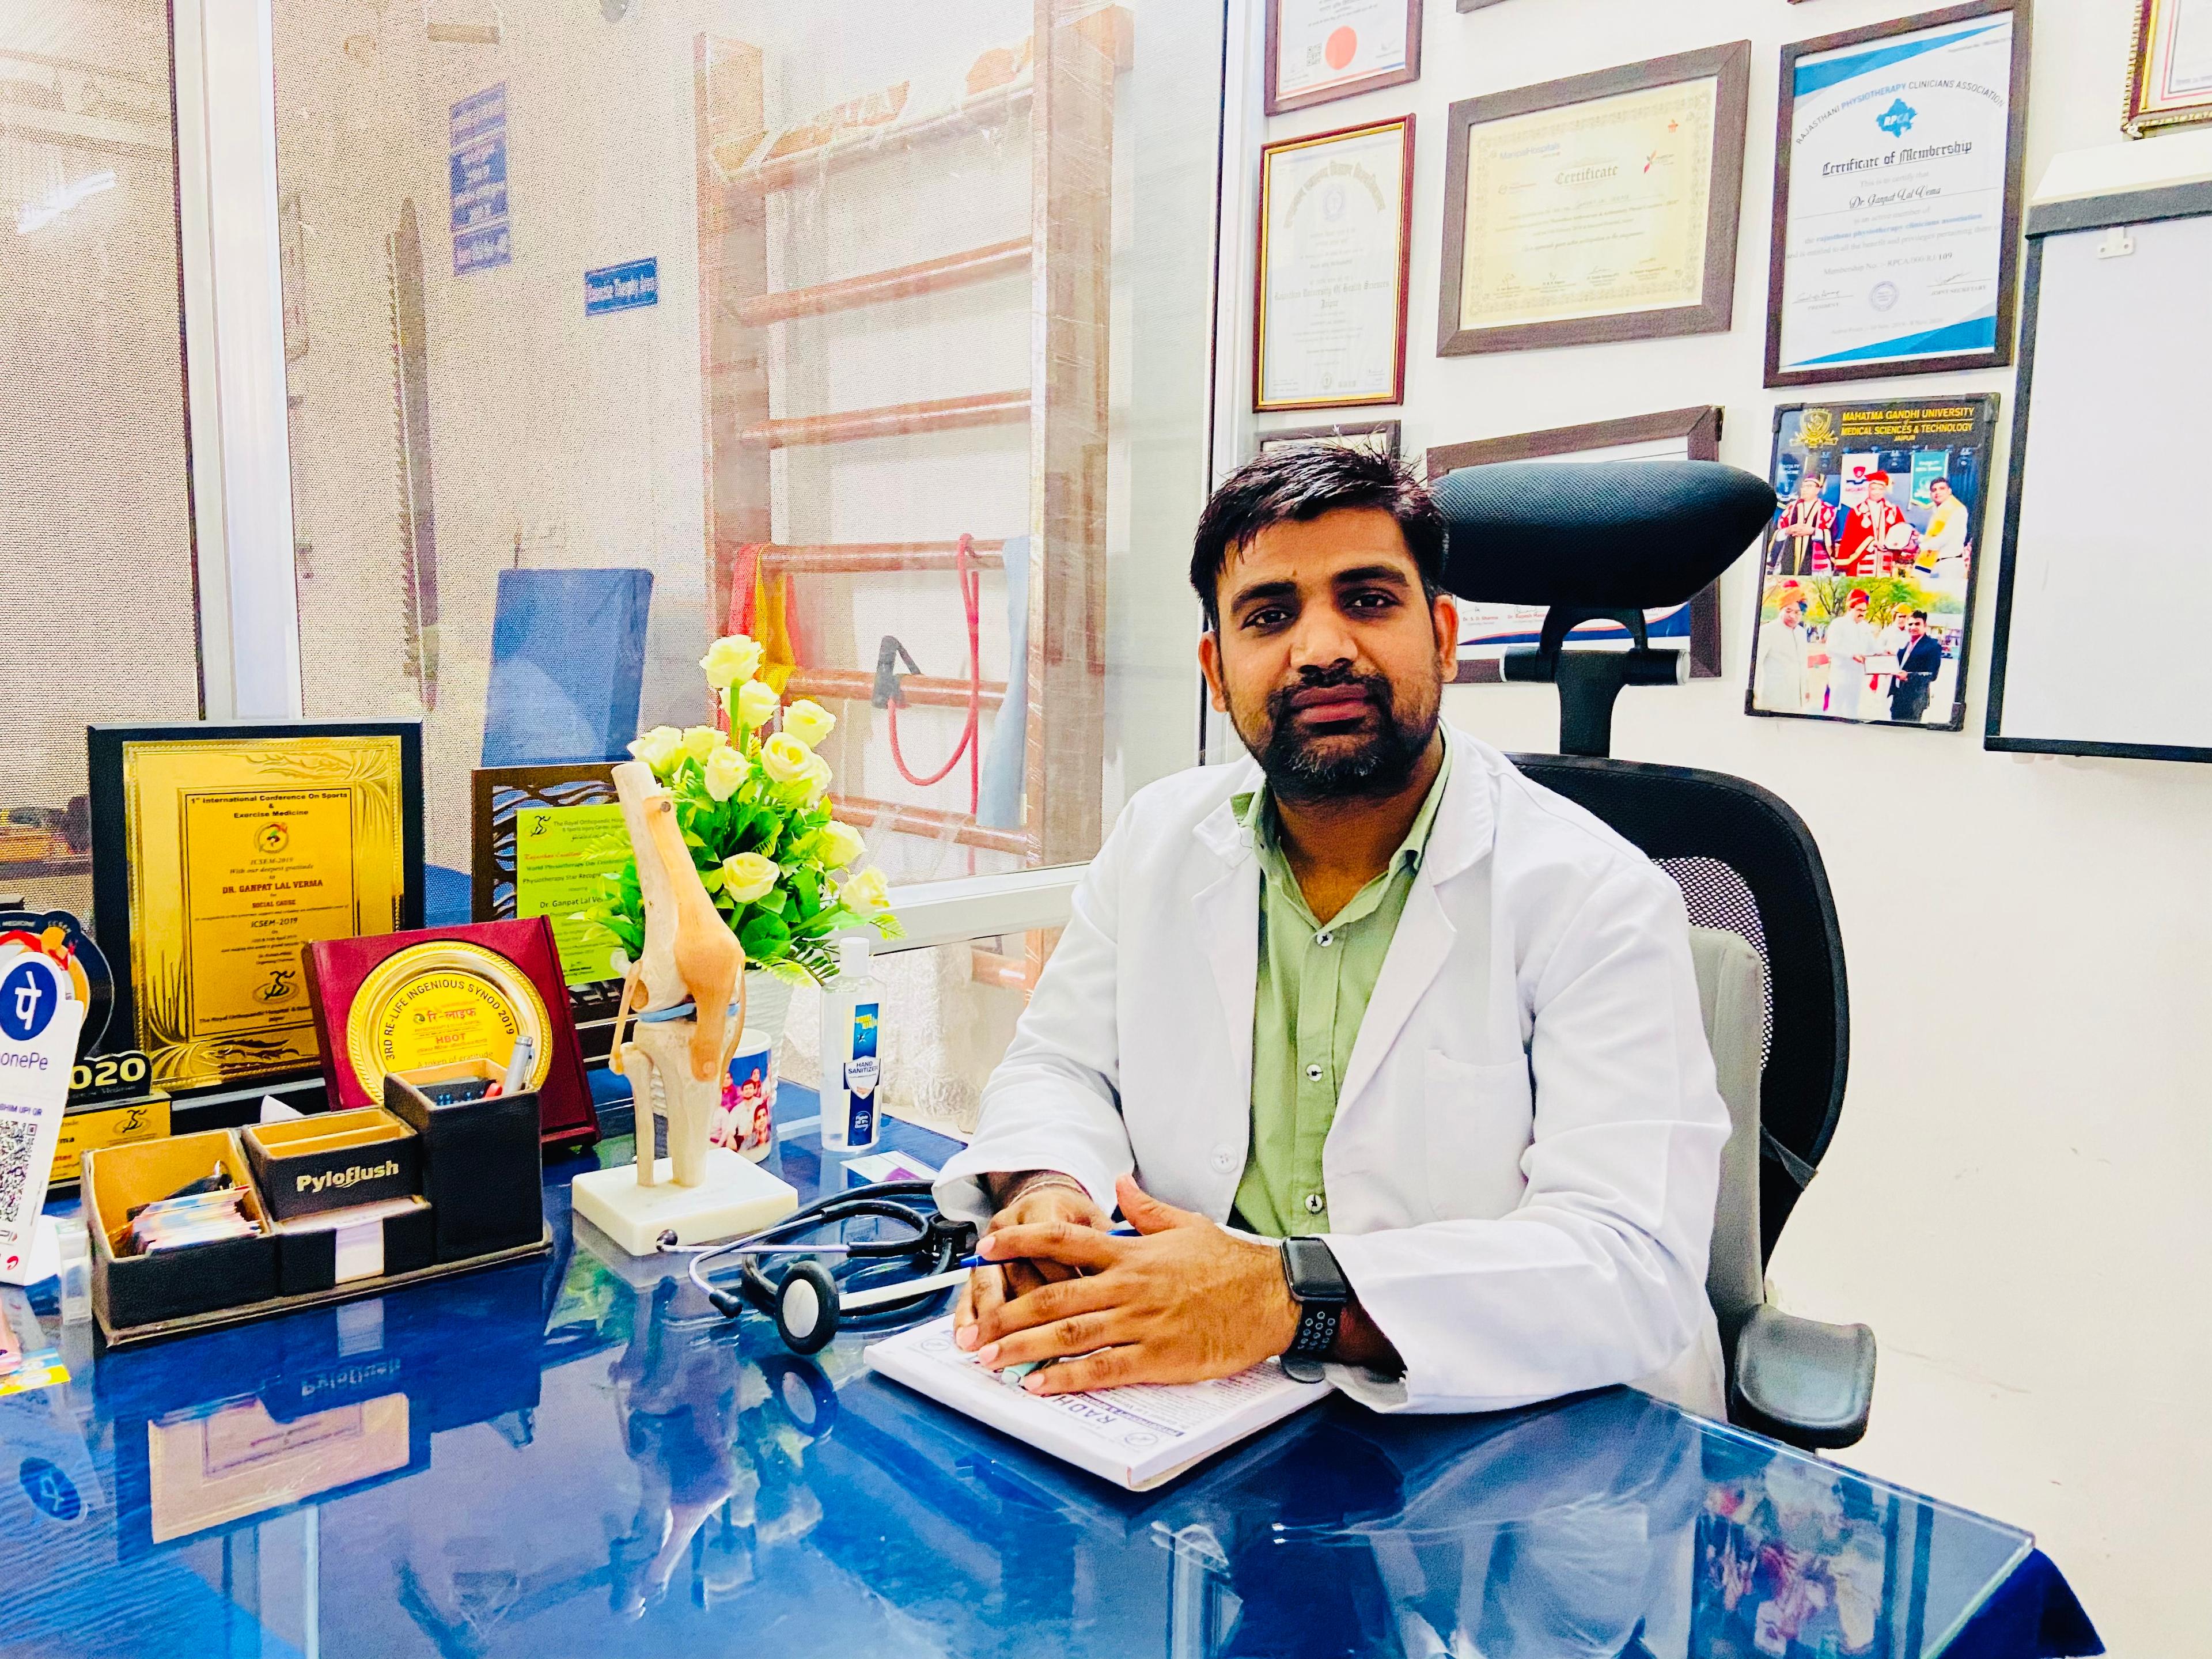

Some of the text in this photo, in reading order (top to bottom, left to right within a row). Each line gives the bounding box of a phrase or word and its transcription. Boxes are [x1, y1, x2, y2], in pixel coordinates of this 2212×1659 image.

[1796, 80, 2005, 144] RAJASTHANI PHYSIOTHERAPY CLINICIANS ASSOCIATION
[1884, 113, 1910, 127] RPCA
[1822, 141, 1972, 176] Certificate of Membership
[1555, 165, 1618, 185] Certificate
[1842, 407, 1975, 422] MAHATMA GANDHI UNIVERSITY
[1841, 426, 1872, 436] MEDICAL
[1874, 425, 1911, 435] SCIENCES
[1921, 422, 1974, 432] TECHNOLOGY
[203, 796, 257, 804] International
[260, 794, 306, 802] Conference
[239, 883, 273, 893] GANPAT
[275, 882, 291, 890] LAL
[293, 879, 323, 888] VERMA
[522, 876, 565, 884] Physiotherapy
[552, 899, 579, 908] Ganpat
[581, 896, 591, 904] Lal
[407, 979, 464, 1000] INGENIOUS
[468, 984, 501, 1010] SYNOD
[384, 998, 408, 1037] RE-LIFE
[498, 1010, 515, 1035] 2019
[436, 1033, 466, 1044] HBOT
[385, 1039, 395, 1060] 3RD
[1, 1052, 48, 1070] onePe
[848, 1066, 879, 1074] SANITIZER
[69, 1058, 146, 1089] 020
[296, 1160, 399, 1193] Pyloflush
[1052, 1395, 1118, 1424] RADH
